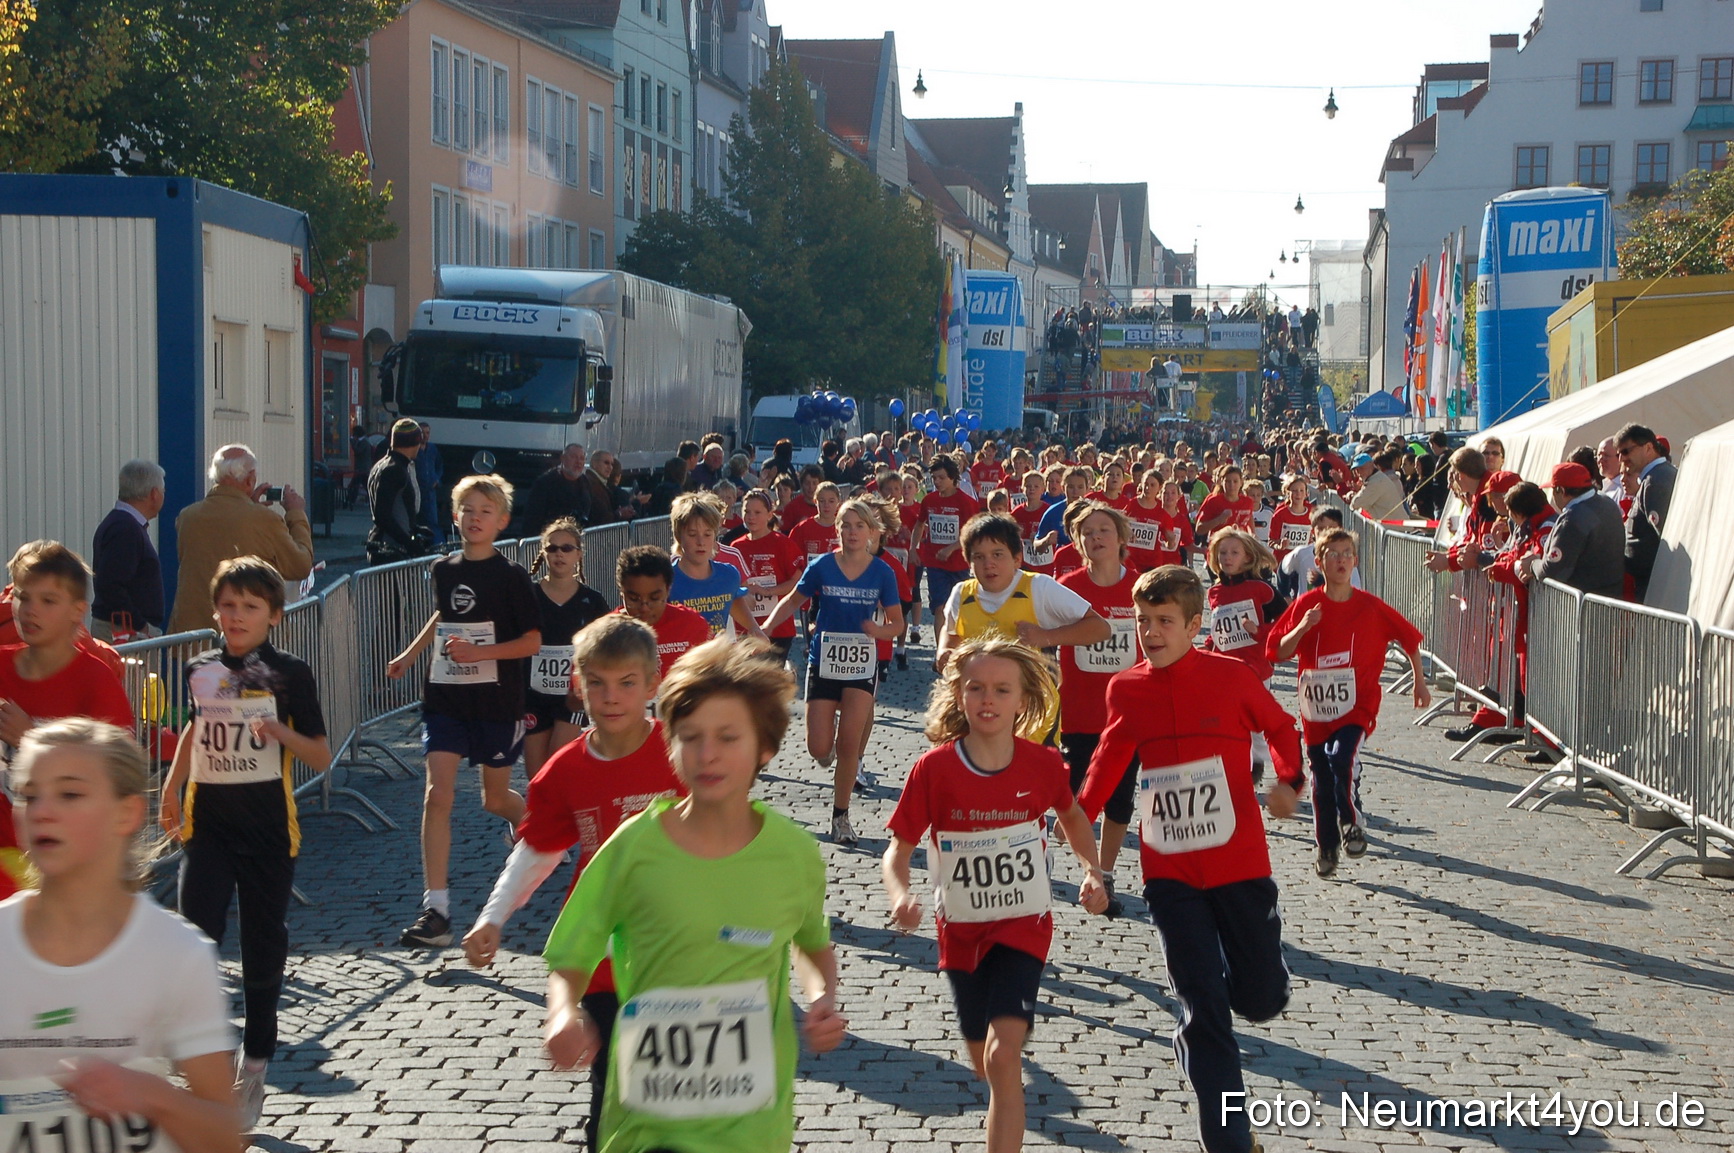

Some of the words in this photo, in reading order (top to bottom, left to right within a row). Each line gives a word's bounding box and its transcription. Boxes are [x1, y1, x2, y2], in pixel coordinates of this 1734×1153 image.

[1508, 210, 1596, 257] maxi
[967, 288, 1008, 315] axi
[1477, 281, 1489, 305] sl
[453, 305, 540, 324] BOCK
[982, 329, 1005, 346] dsl
[1125, 328, 1184, 342] BOCK
[1151, 353, 1205, 367] TART
[931, 521, 956, 534] 4043
[1284, 530, 1308, 541] 4033
[684, 593, 732, 607] NEUMARKTER
[690, 603, 726, 613] ADTLAUF
[826, 645, 870, 663] 4035
[1089, 653, 1121, 666] Lukas
[537, 658, 571, 677] 402
[829, 663, 866, 674] Theresa
[1304, 682, 1349, 703] 4045
[1315, 704, 1339, 715] Leon
[206, 754, 258, 772] Tobias
[1151, 783, 1221, 822] 4072
[969, 808, 1029, 821] Straßenlauf
[1163, 820, 1217, 842] Florian
[953, 837, 998, 848] PFLEIDERER
[952, 849, 1035, 889] 4063
[970, 888, 1025, 910] Ulrich
[635, 1016, 749, 1070] 4071
[642, 1073, 756, 1102] Nikolaus
